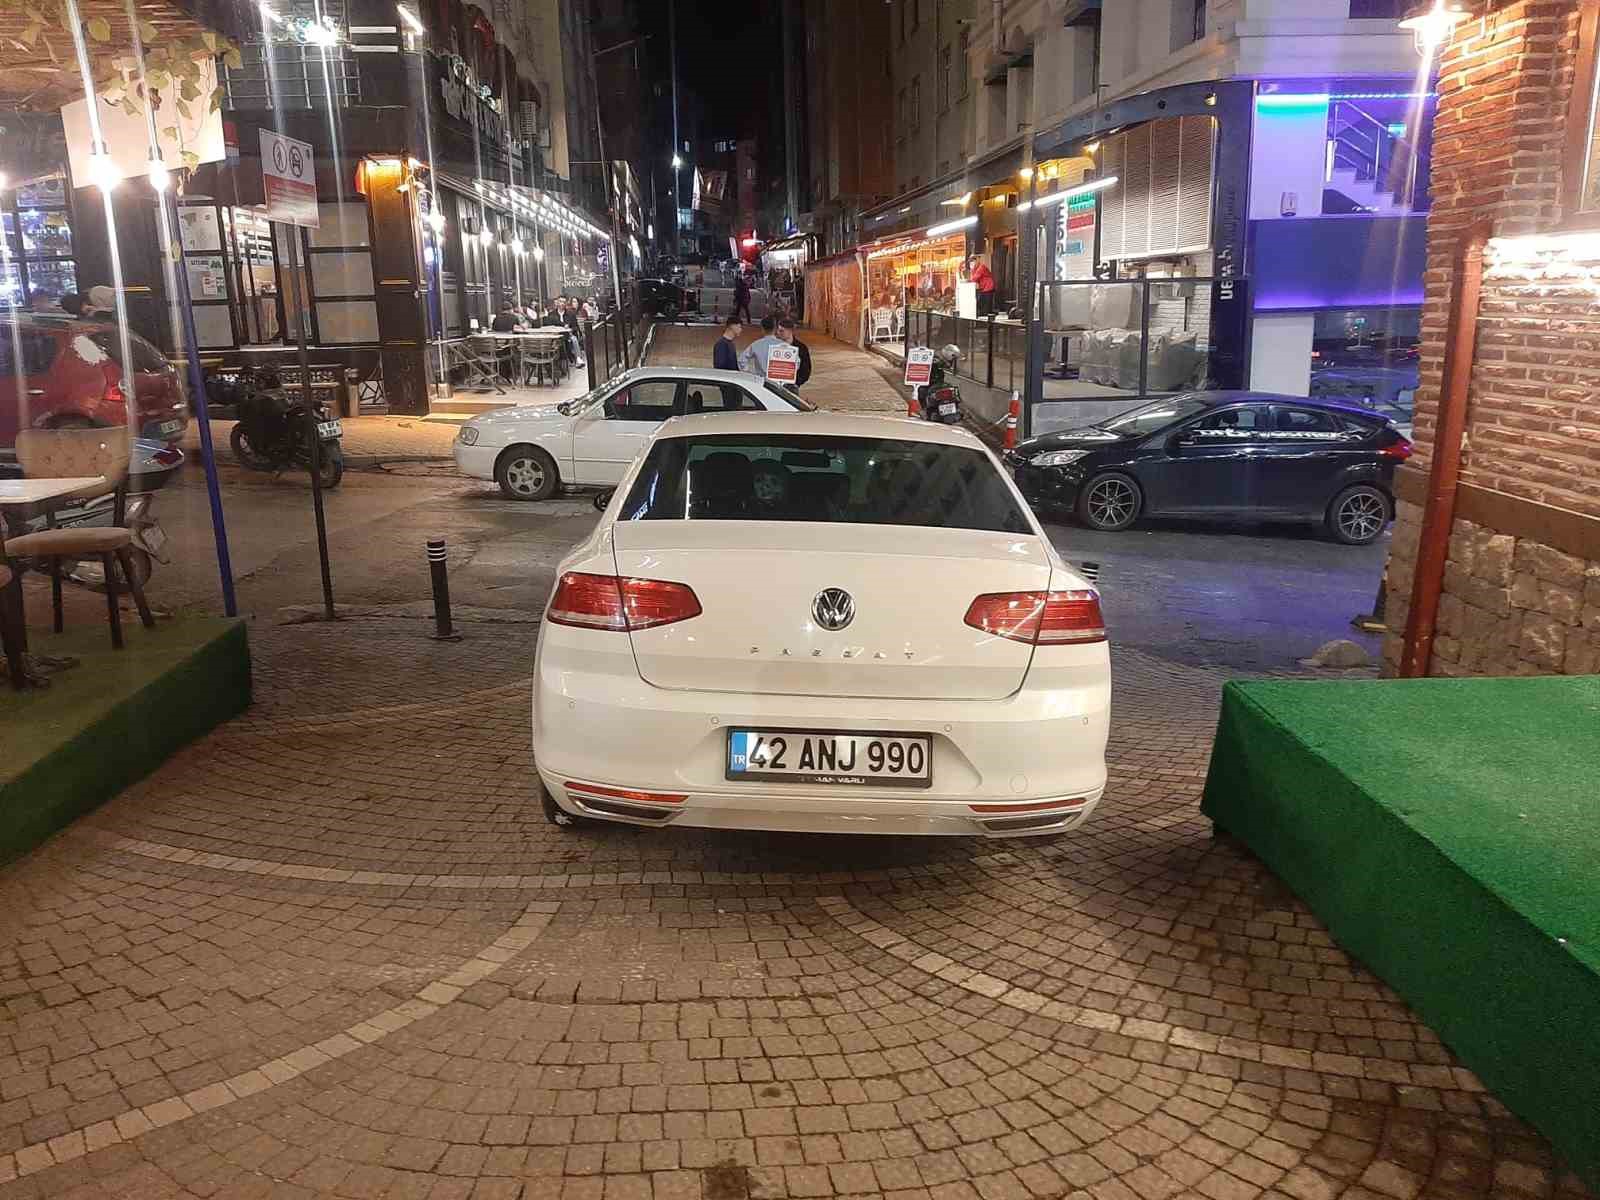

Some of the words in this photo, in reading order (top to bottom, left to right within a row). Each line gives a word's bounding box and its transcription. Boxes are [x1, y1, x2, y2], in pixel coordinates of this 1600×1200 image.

[750, 737, 787, 769] 42
[799, 738, 856, 771] ANJ
[867, 740, 924, 774] 990
